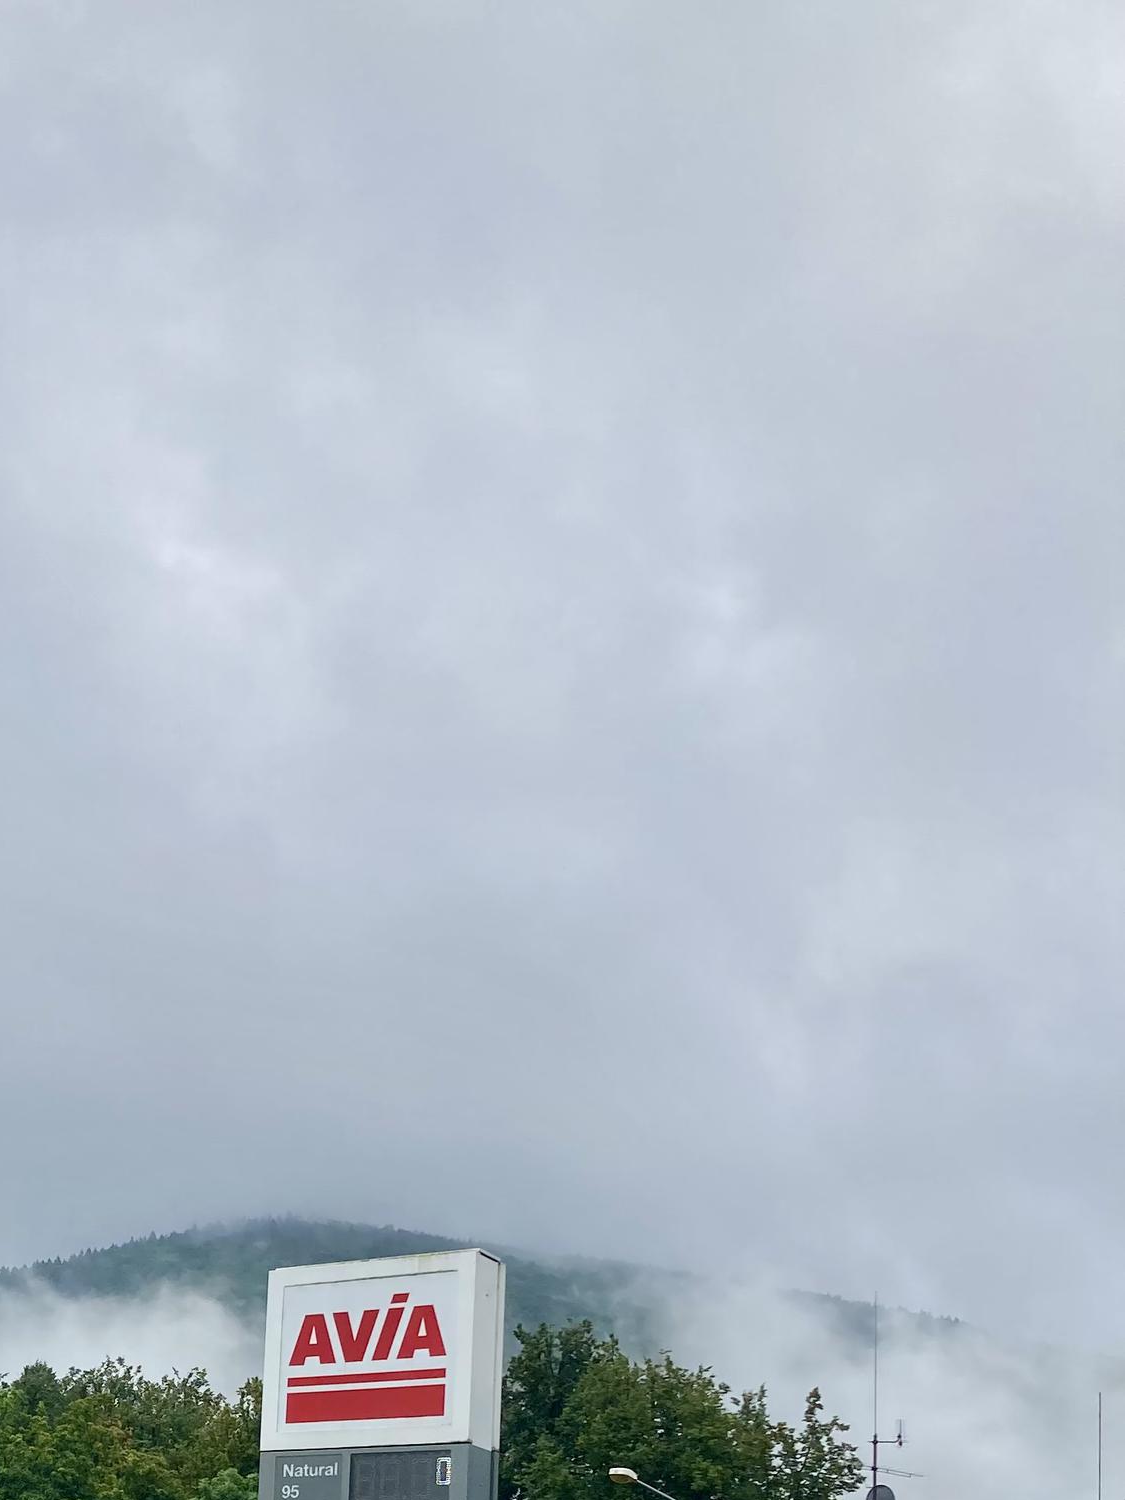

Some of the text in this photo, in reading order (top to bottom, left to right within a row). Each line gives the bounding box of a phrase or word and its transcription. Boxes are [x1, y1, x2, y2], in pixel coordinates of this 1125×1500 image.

[289, 1292, 447, 1367] AVIA
[282, 1462, 339, 1478] Natural
[281, 1485, 300, 1499] 95
